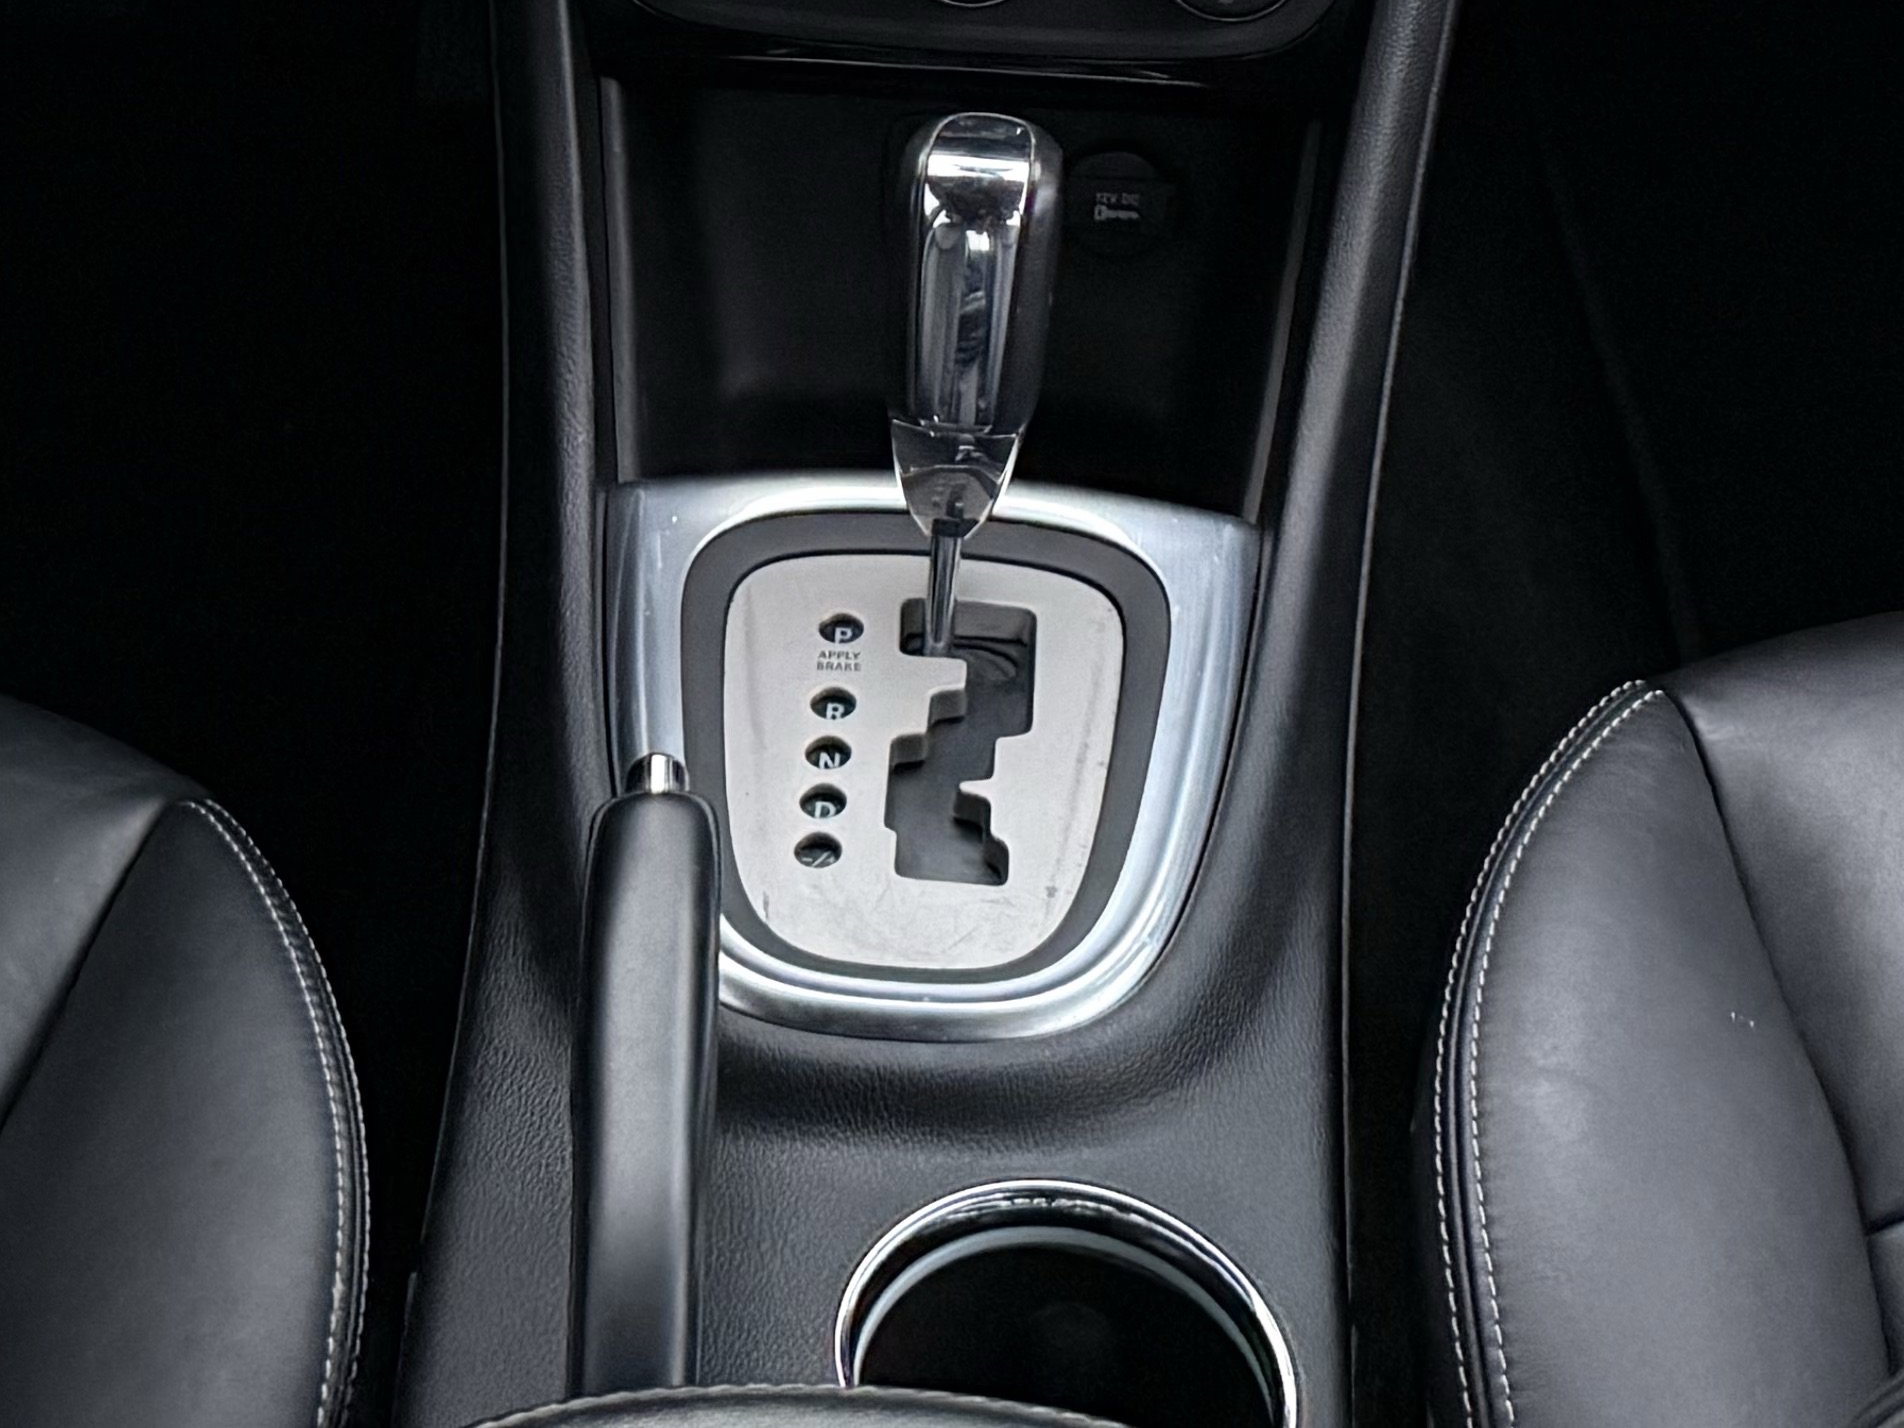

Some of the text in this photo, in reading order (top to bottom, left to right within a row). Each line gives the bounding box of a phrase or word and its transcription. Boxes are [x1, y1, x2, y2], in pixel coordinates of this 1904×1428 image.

[834, 626, 852, 643] P
[818, 650, 861, 661] APPLY
[816, 661, 862, 672] BRAKE
[826, 703, 845, 720] R
[819, 752, 839, 769] N
[814, 801, 836, 817] D
